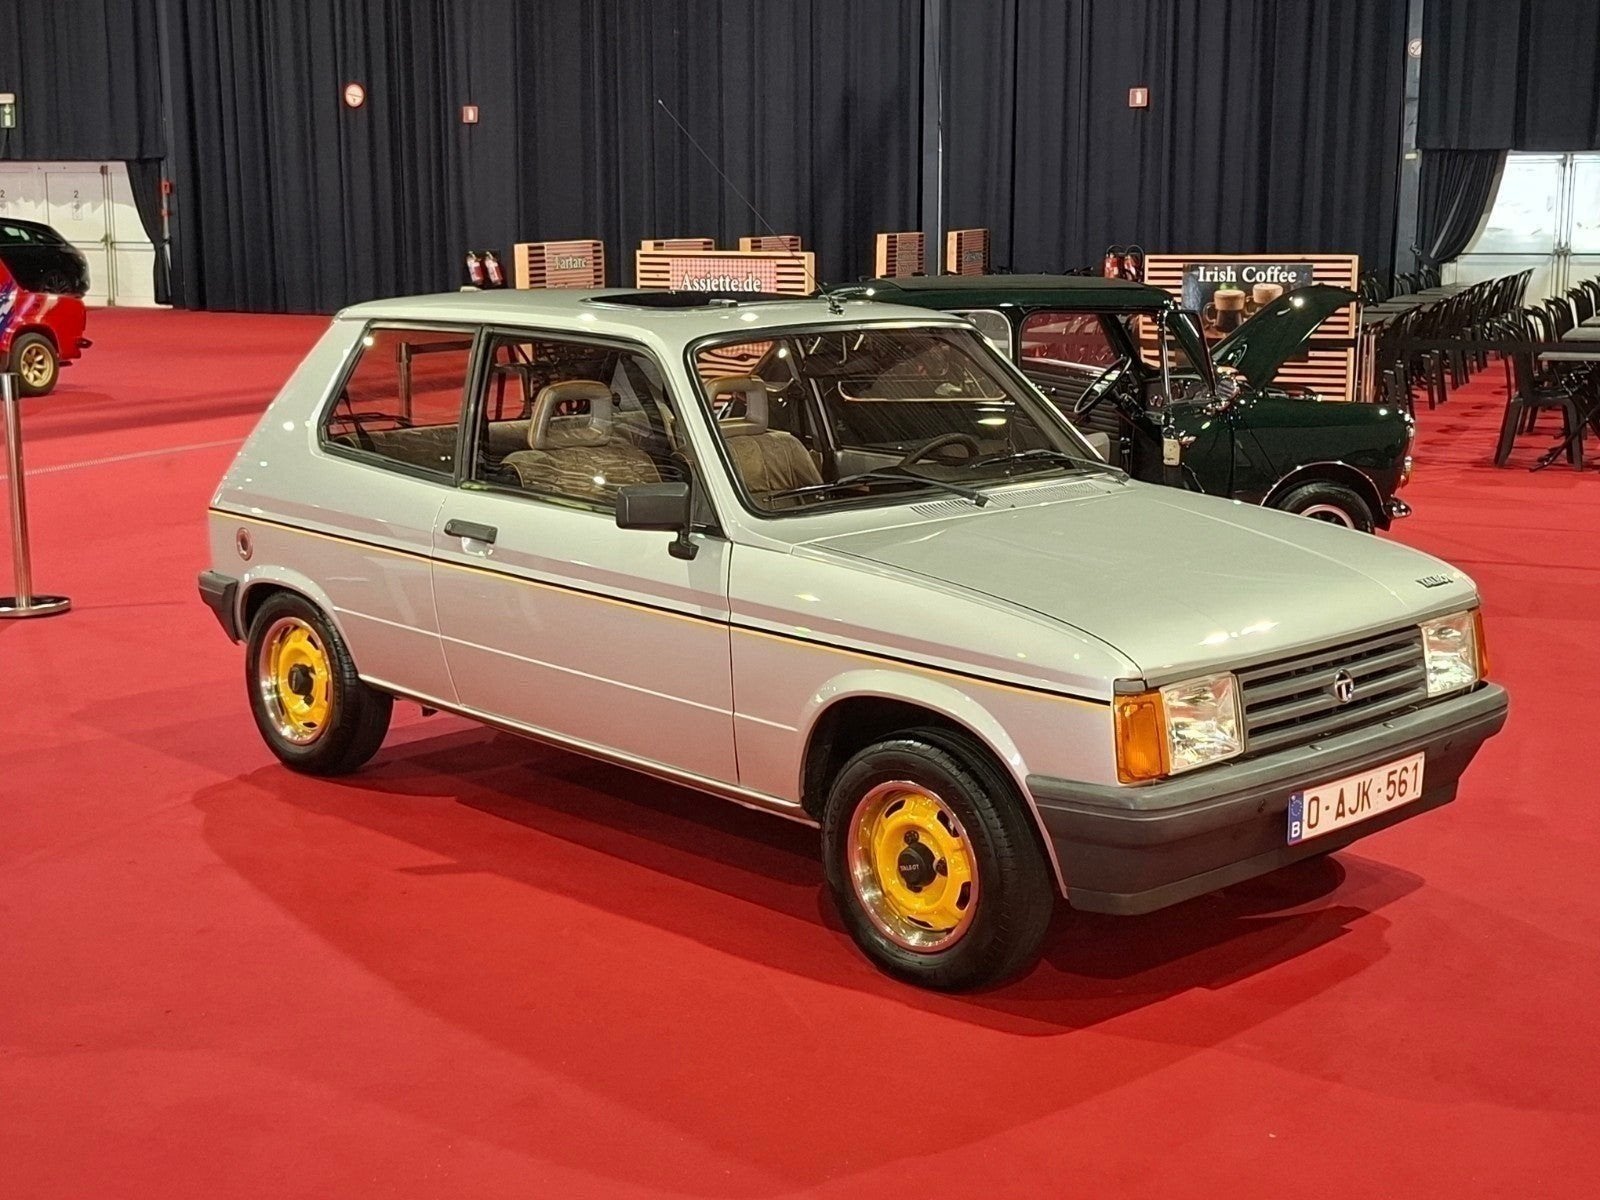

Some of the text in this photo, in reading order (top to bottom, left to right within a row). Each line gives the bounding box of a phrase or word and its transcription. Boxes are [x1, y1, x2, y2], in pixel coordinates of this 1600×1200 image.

[0, 189, 6, 198] 2
[73, 190, 79, 199] 2
[680, 272, 762, 292] Assiette de
[1198, 265, 1297, 283] Irish Coffee
[1291, 821, 1300, 838] B
